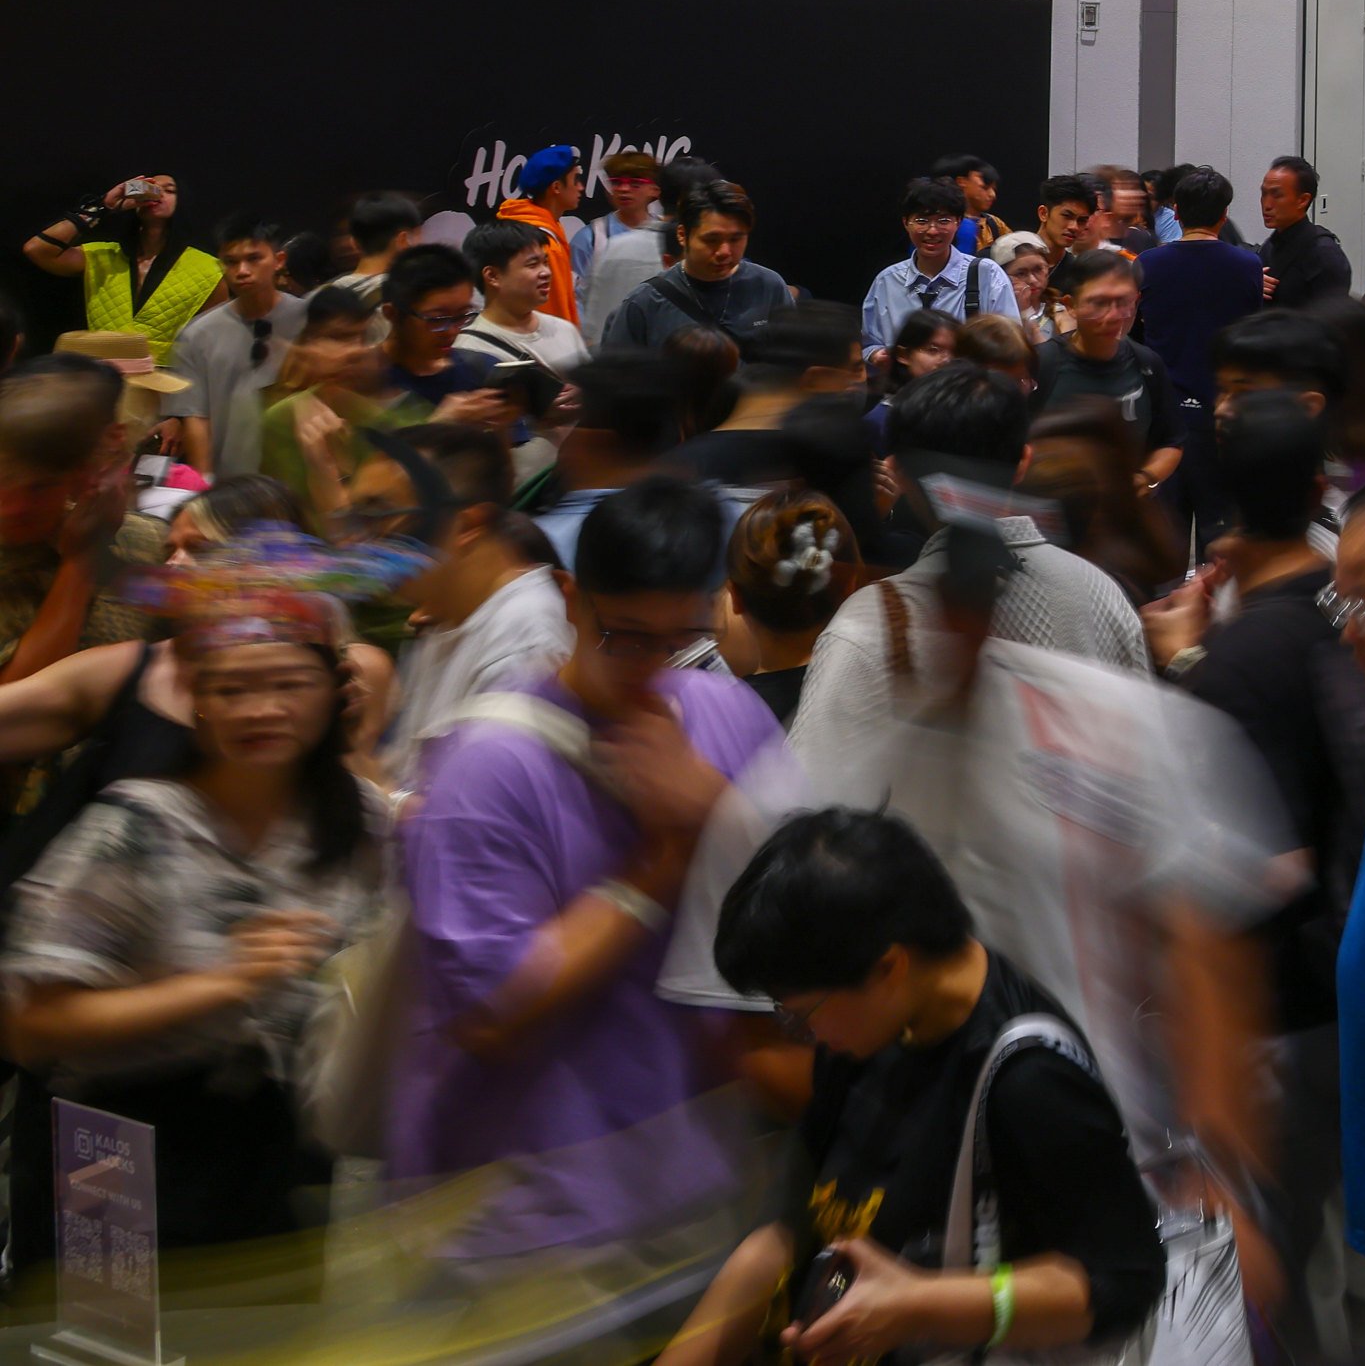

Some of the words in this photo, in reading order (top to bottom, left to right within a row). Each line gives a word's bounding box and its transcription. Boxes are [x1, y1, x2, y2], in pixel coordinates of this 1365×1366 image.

[94, 1132, 131, 1157] KALOS
[108, 1191, 130, 1207] WITH
[130, 1200, 143, 1211] US
